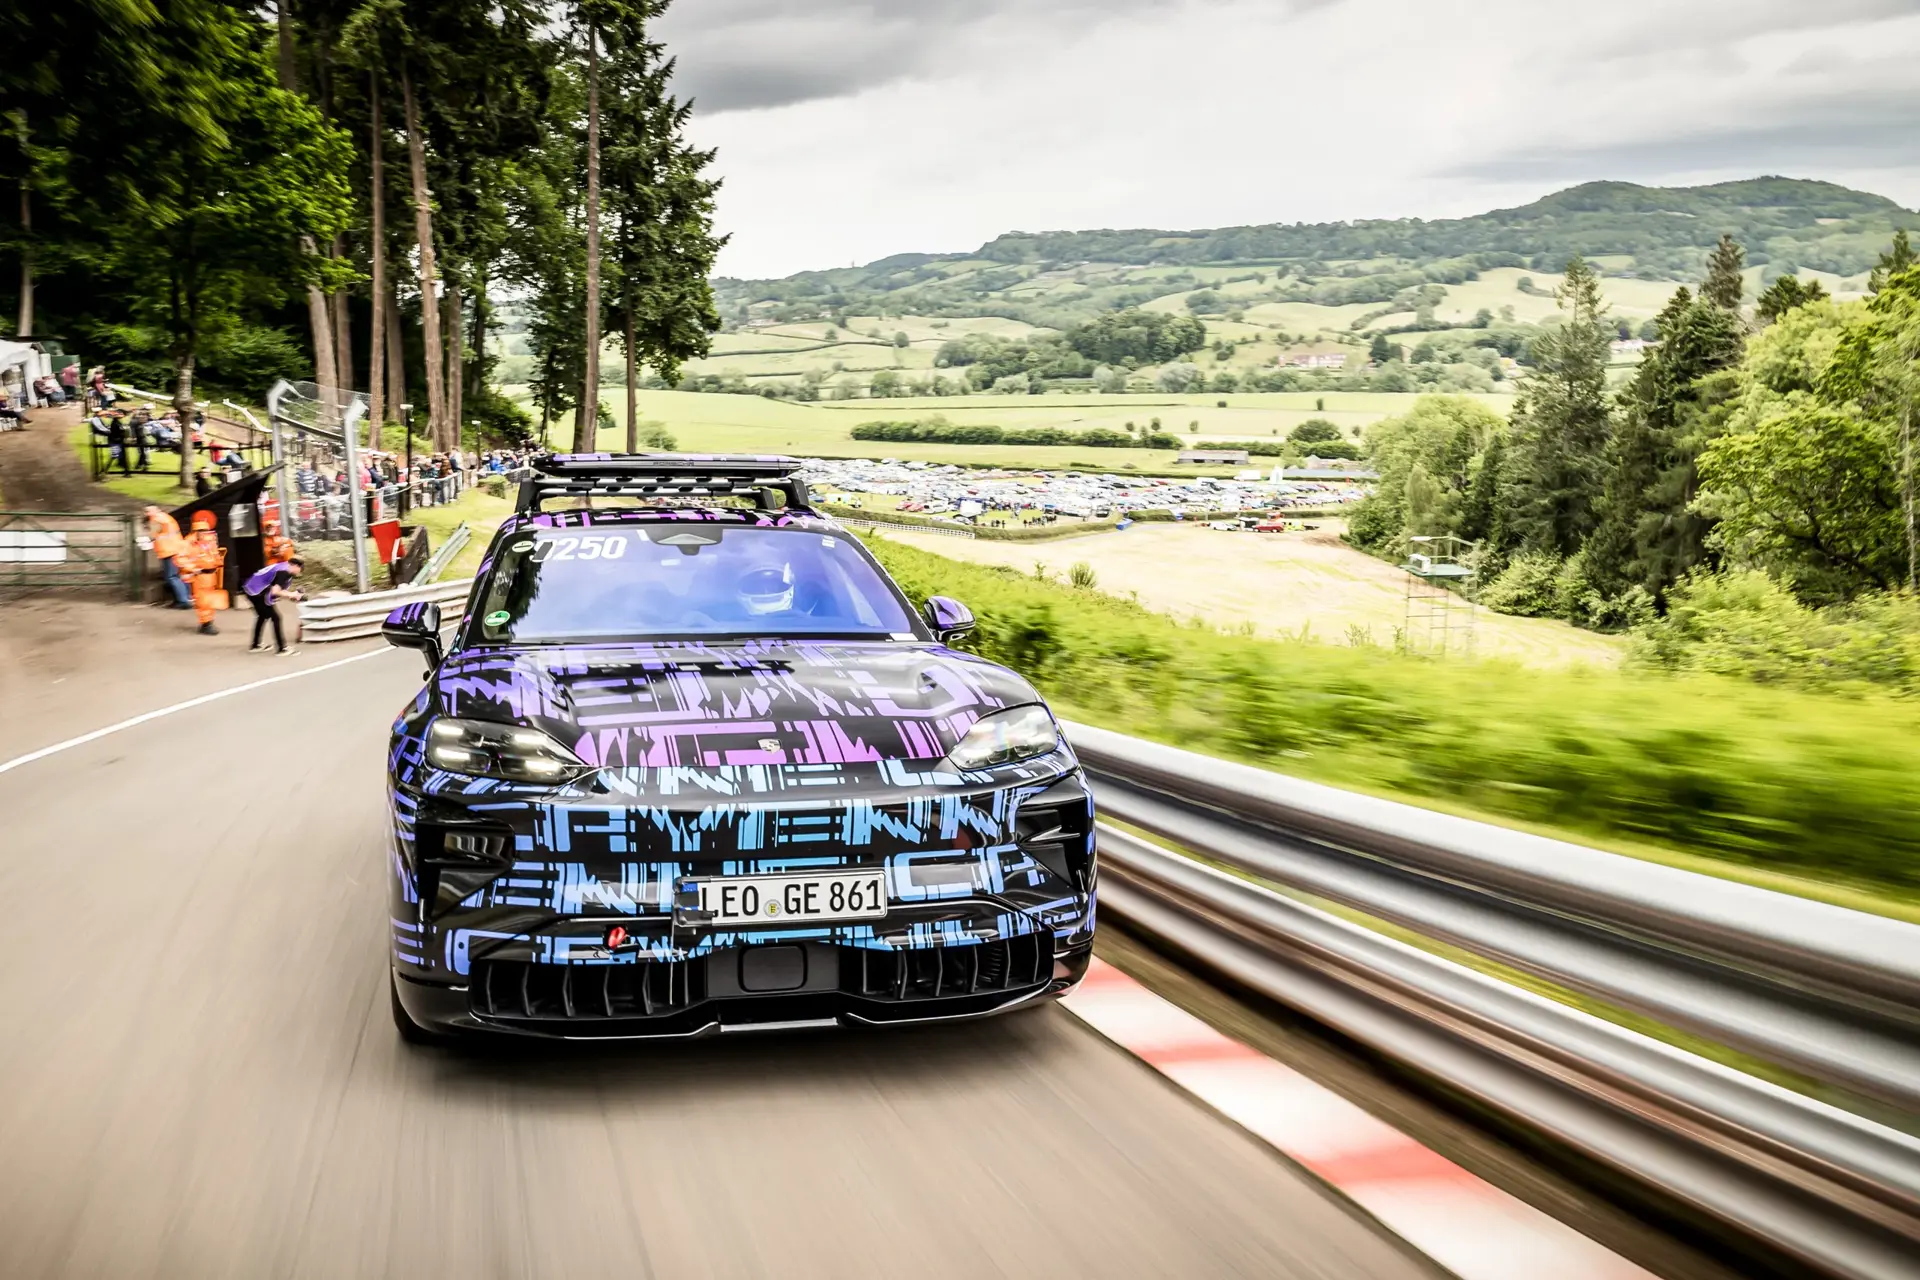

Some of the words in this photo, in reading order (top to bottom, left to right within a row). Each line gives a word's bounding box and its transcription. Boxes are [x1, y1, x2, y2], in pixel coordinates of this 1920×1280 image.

[702, 885, 759, 917] LEO
[784, 883, 821, 914] GE
[829, 880, 882, 912] 861
